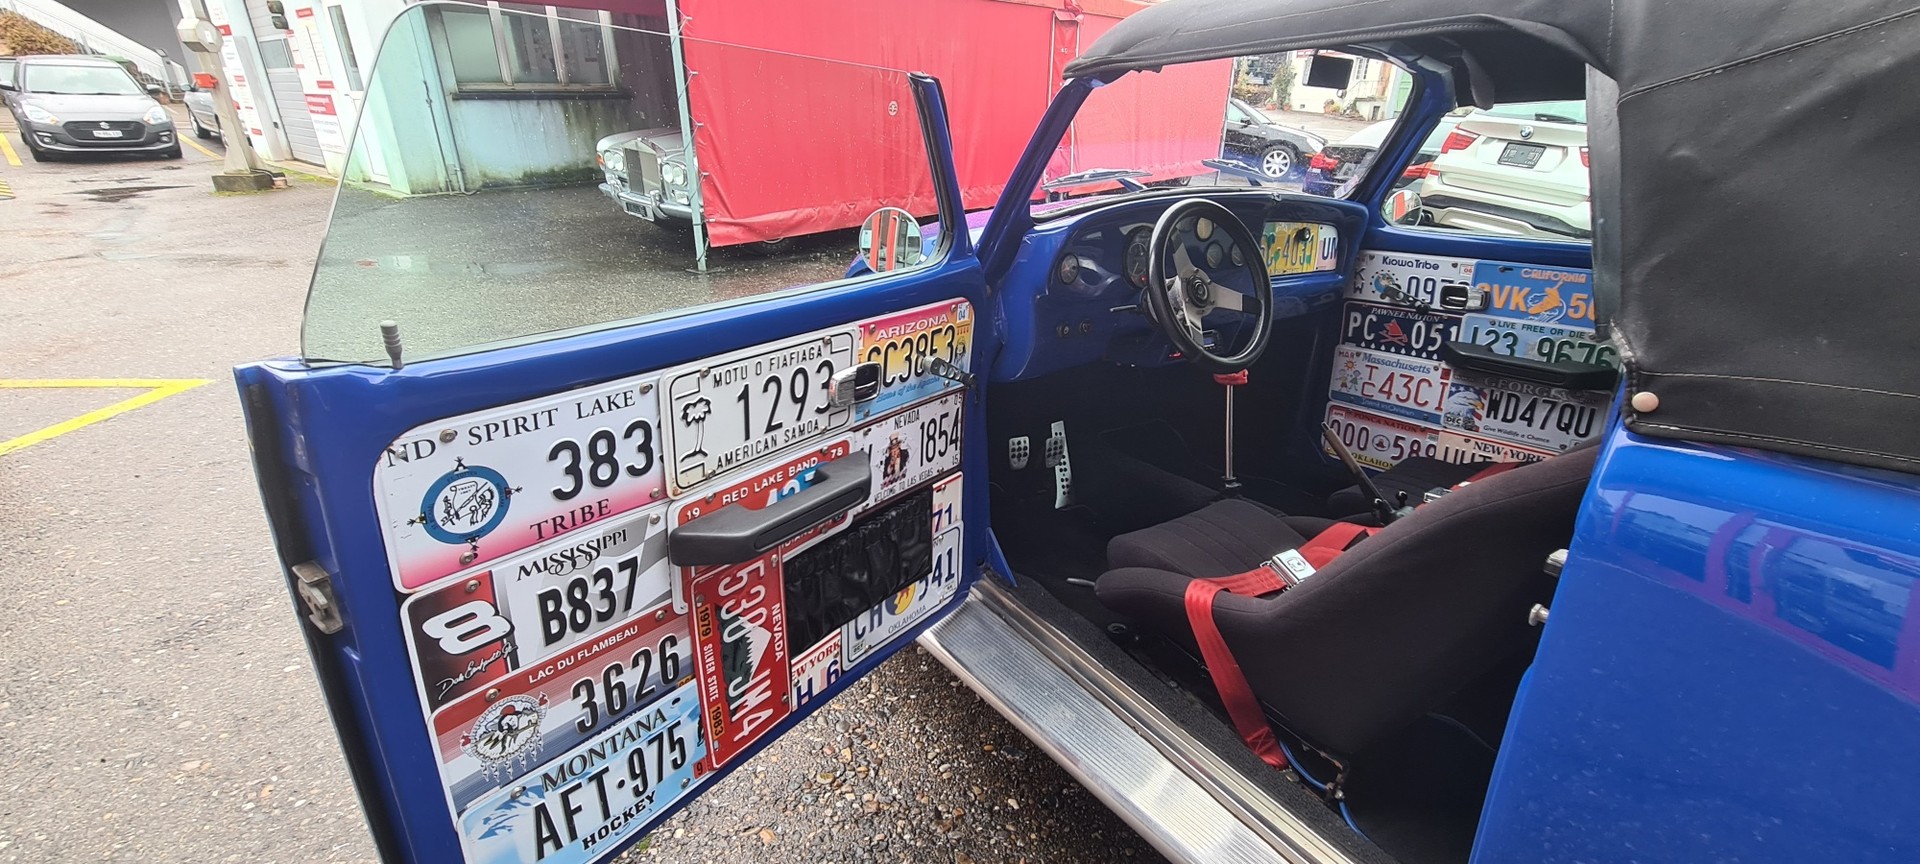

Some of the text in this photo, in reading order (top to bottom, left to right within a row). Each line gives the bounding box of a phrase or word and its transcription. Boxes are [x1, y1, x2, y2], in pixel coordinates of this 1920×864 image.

[1382, 256, 1440, 270] Kiowa Tribe
[1520, 268, 1587, 284] CALIFORNIA
[1371, 307, 1440, 322] PAWNEE NATION
[1477, 282, 1532, 312] VK
[876, 314, 948, 340] ARIZONA
[1348, 312, 1377, 341] PC
[1498, 320, 1585, 339] LIVE FREE OR DIE
[713, 345, 823, 389] MOTU O FIAFIAGA
[1362, 353, 1431, 375] Massachusetts
[467, 408, 558, 446] SPIRIT
[575, 389, 636, 421] LAKE
[736, 359, 834, 443] 1293
[894, 409, 920, 430] NEVADA
[1446, 416, 1461, 425] DEC
[1486, 389, 1597, 438] WD47QU
[716, 419, 820, 470] AMERICAN SAMOA
[920, 407, 960, 467] 1854
[1382, 419, 1417, 432] NATION
[1483, 424, 1496, 432] Give
[1497, 427, 1520, 438] Wildlife
[1527, 434, 1550, 443] Chance
[548, 416, 665, 501] 383
[1473, 441, 1504, 456] NEW
[686, 507, 700, 520] 19
[722, 487, 748, 506] RED
[754, 471, 784, 492] LAKE
[788, 456, 818, 476] BAND
[830, 446, 844, 459] 78
[899, 480, 906, 490] TO
[907, 475, 917, 487] LAS
[919, 467, 934, 482] VEGAS
[530, 499, 611, 542] TRIBE
[516, 528, 627, 581] MISSISSIPPI
[536, 556, 639, 647] B837
[888, 605, 927, 635] OKLAHOMA
[422, 600, 514, 655] 8
[771, 603, 784, 662] NEVADA
[528, 626, 638, 684] LAC DU FLAMBEAU
[699, 606, 724, 738] 1979 SILVER STATE 1983
[808, 638, 841, 668] YORK
[571, 633, 681, 734] 3626
[540, 708, 668, 793] MONTANA
[582, 791, 657, 851] HOCKEY
